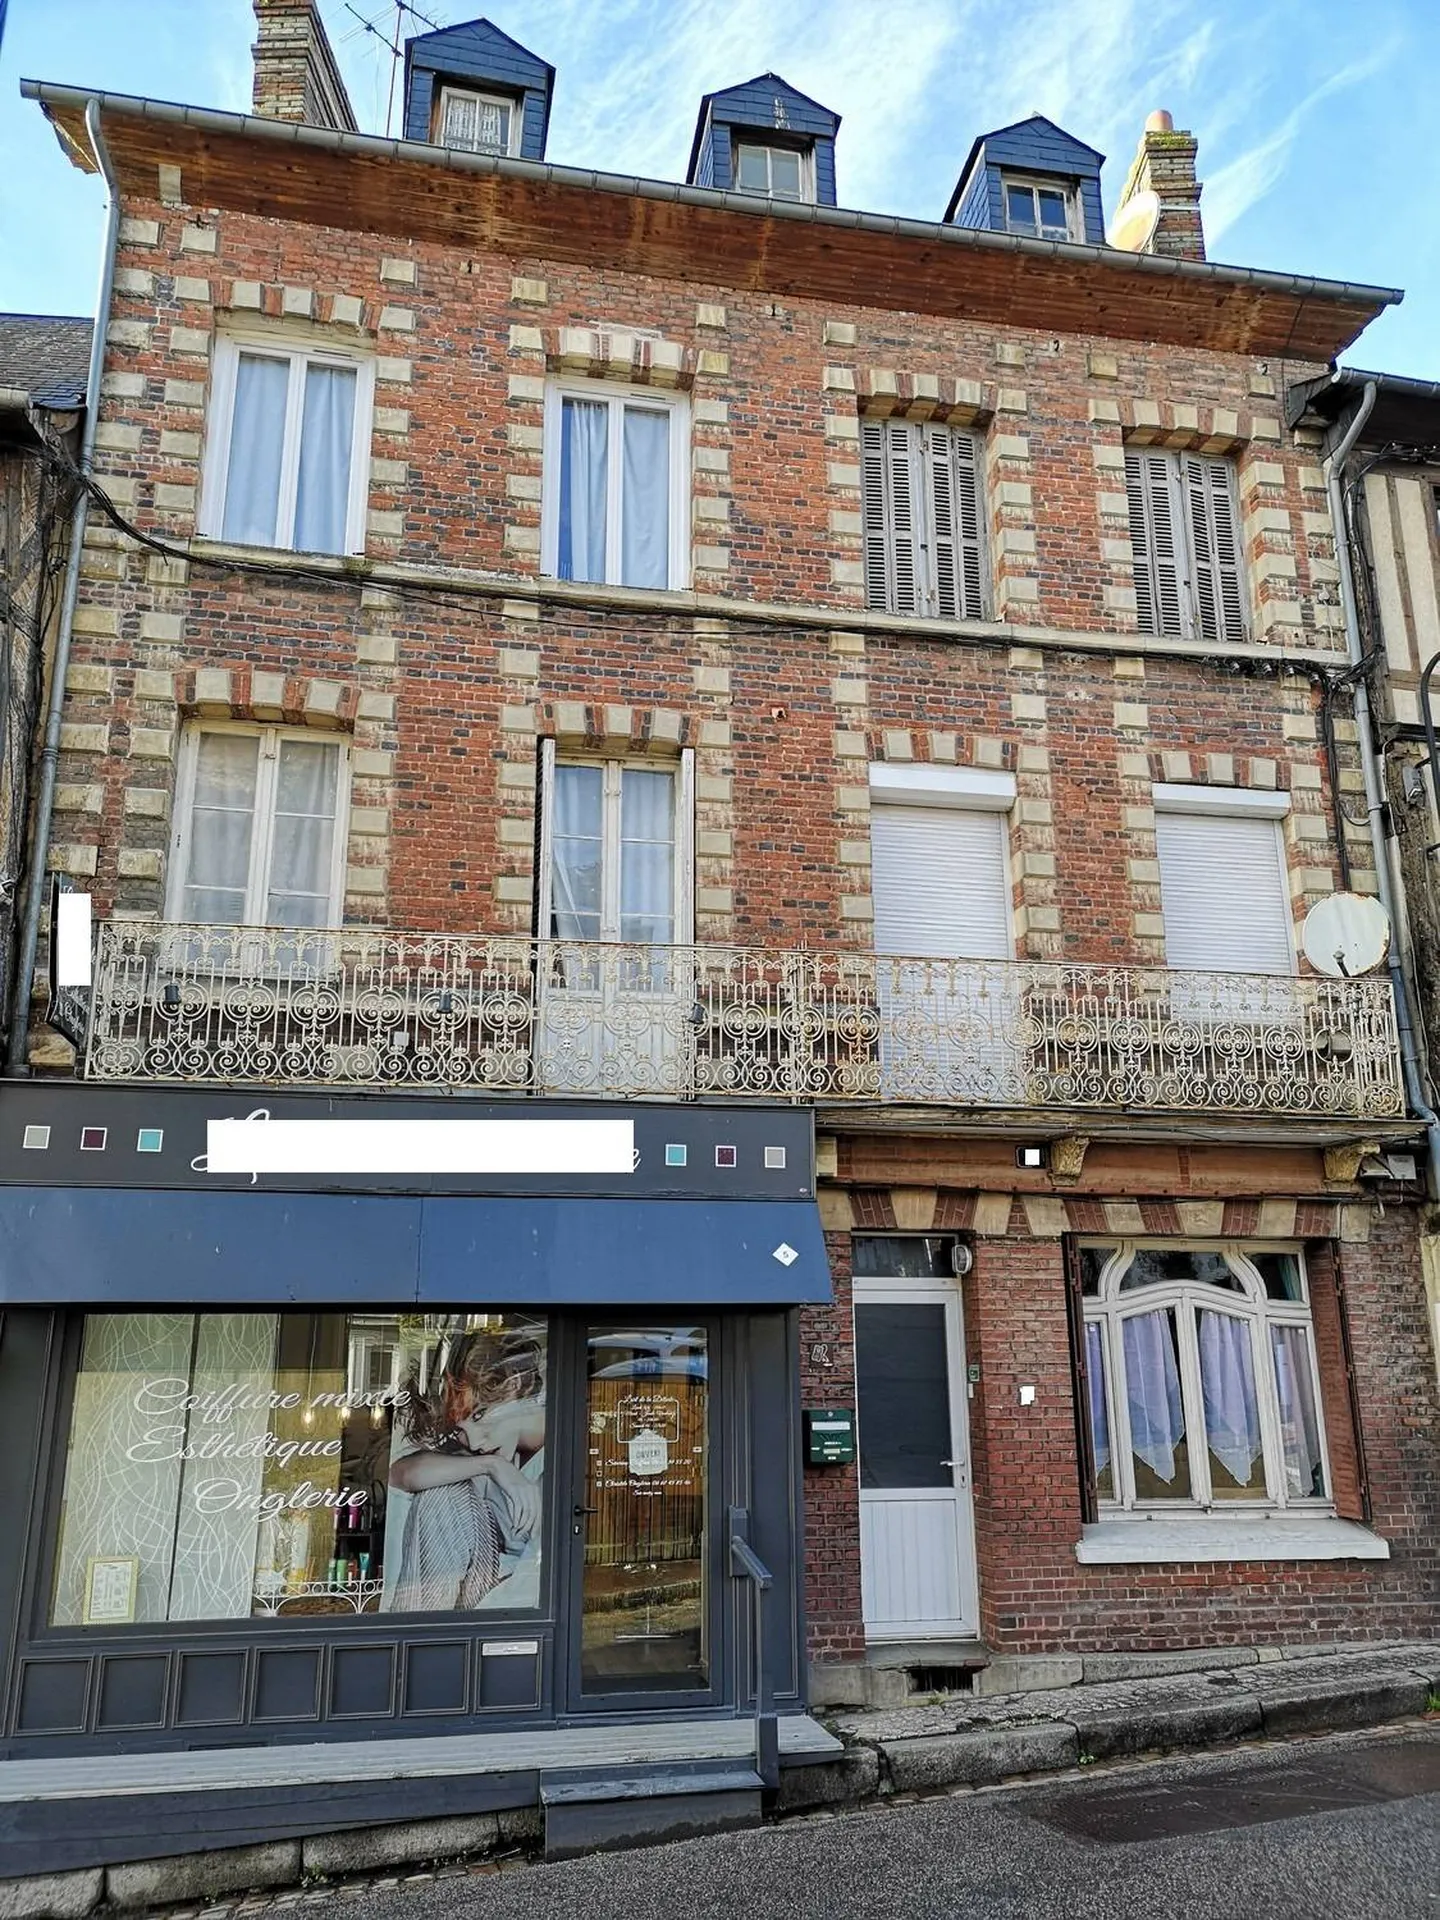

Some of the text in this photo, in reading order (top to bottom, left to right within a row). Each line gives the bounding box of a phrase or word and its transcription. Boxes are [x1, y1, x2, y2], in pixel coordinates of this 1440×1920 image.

[133, 1377, 412, 1424] Coiffure mixte
[126, 1425, 343, 1468] Esthétique
[193, 1477, 368, 1523] Onglerie
